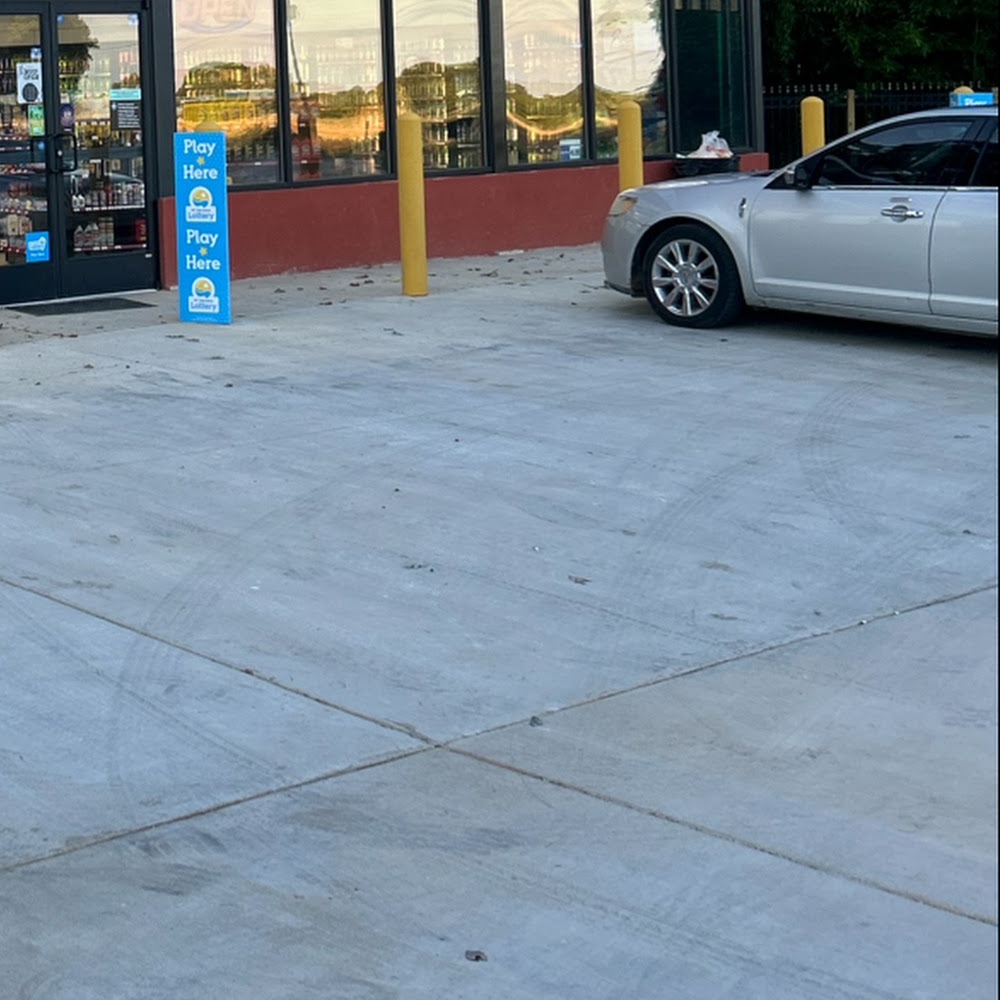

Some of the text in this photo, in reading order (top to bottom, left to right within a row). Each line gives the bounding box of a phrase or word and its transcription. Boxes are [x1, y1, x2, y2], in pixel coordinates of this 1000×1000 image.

[183, 139, 216, 157] Play
[183, 164, 219, 179] Here
[188, 211, 215, 220] Lottery
[186, 229, 219, 247] Play
[186, 254, 221, 270] Here
[190, 302, 217, 310] Lottery
